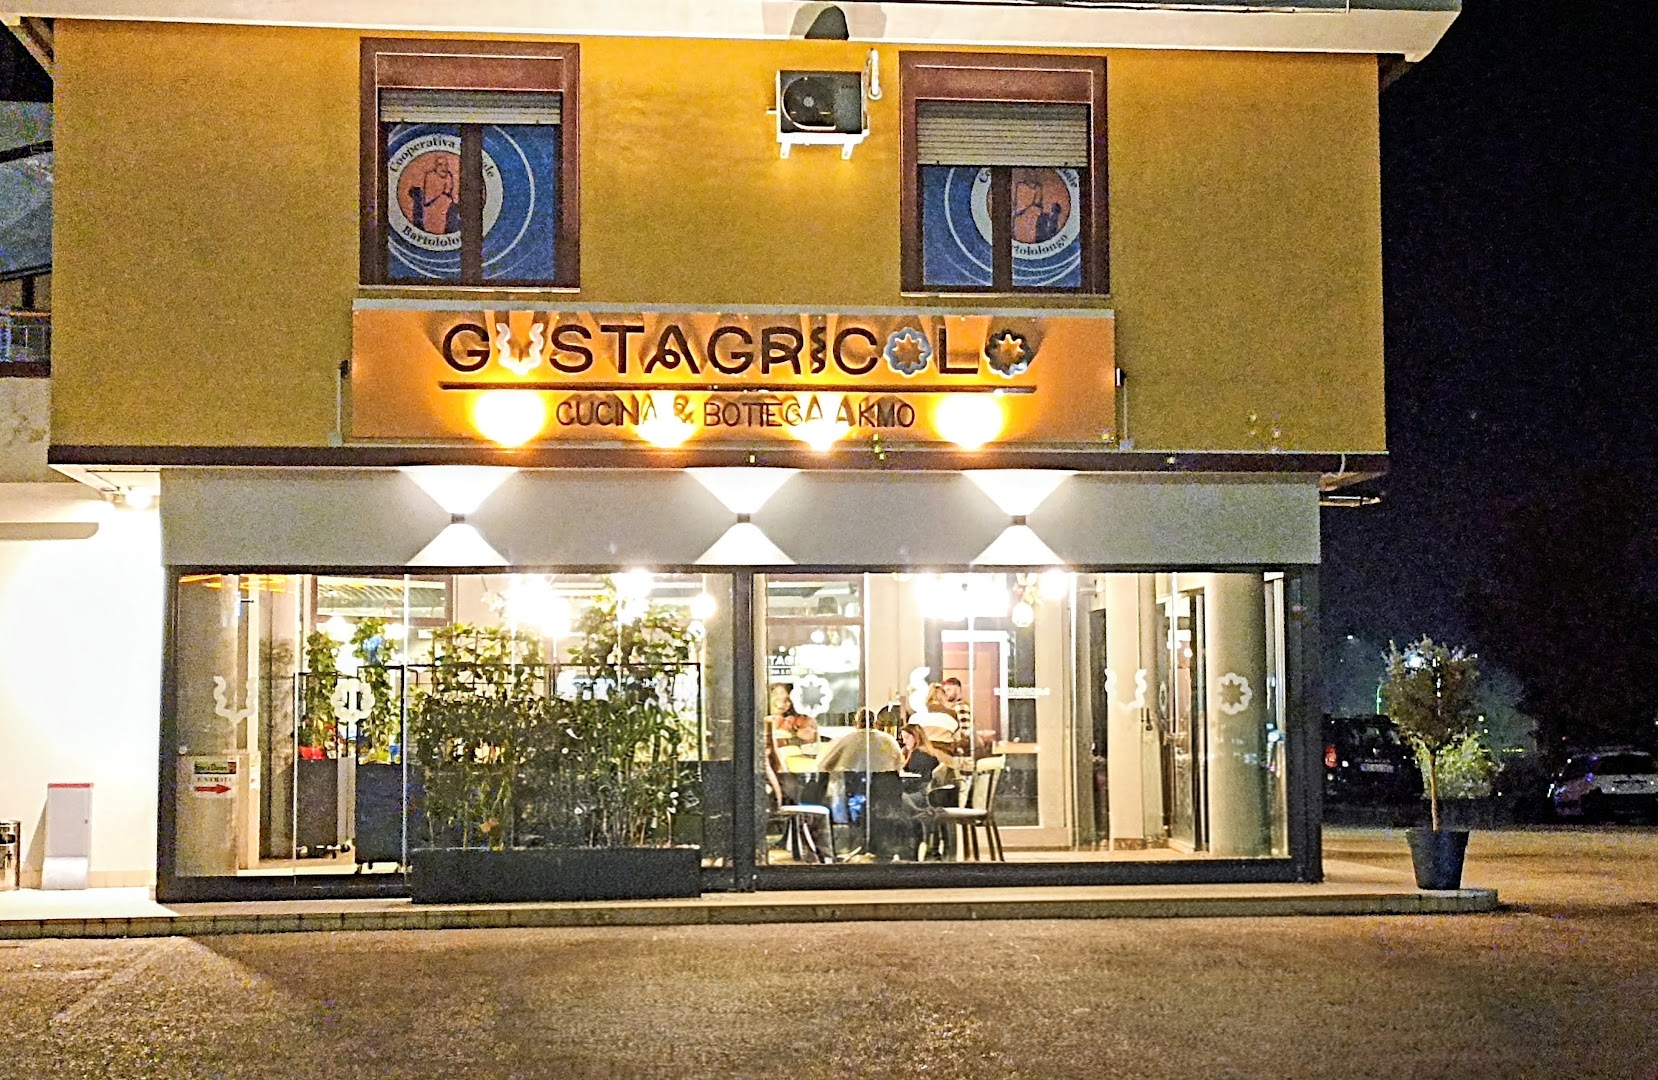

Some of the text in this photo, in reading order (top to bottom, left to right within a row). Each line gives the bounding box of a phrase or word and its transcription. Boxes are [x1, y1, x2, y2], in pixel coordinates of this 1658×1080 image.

[442, 322, 1032, 379] GUSTAGRICOLO
[556, 399, 657, 427] CUCINA
[673, 397, 695, 424] &
[703, 400, 824, 427] BOTTEGA
